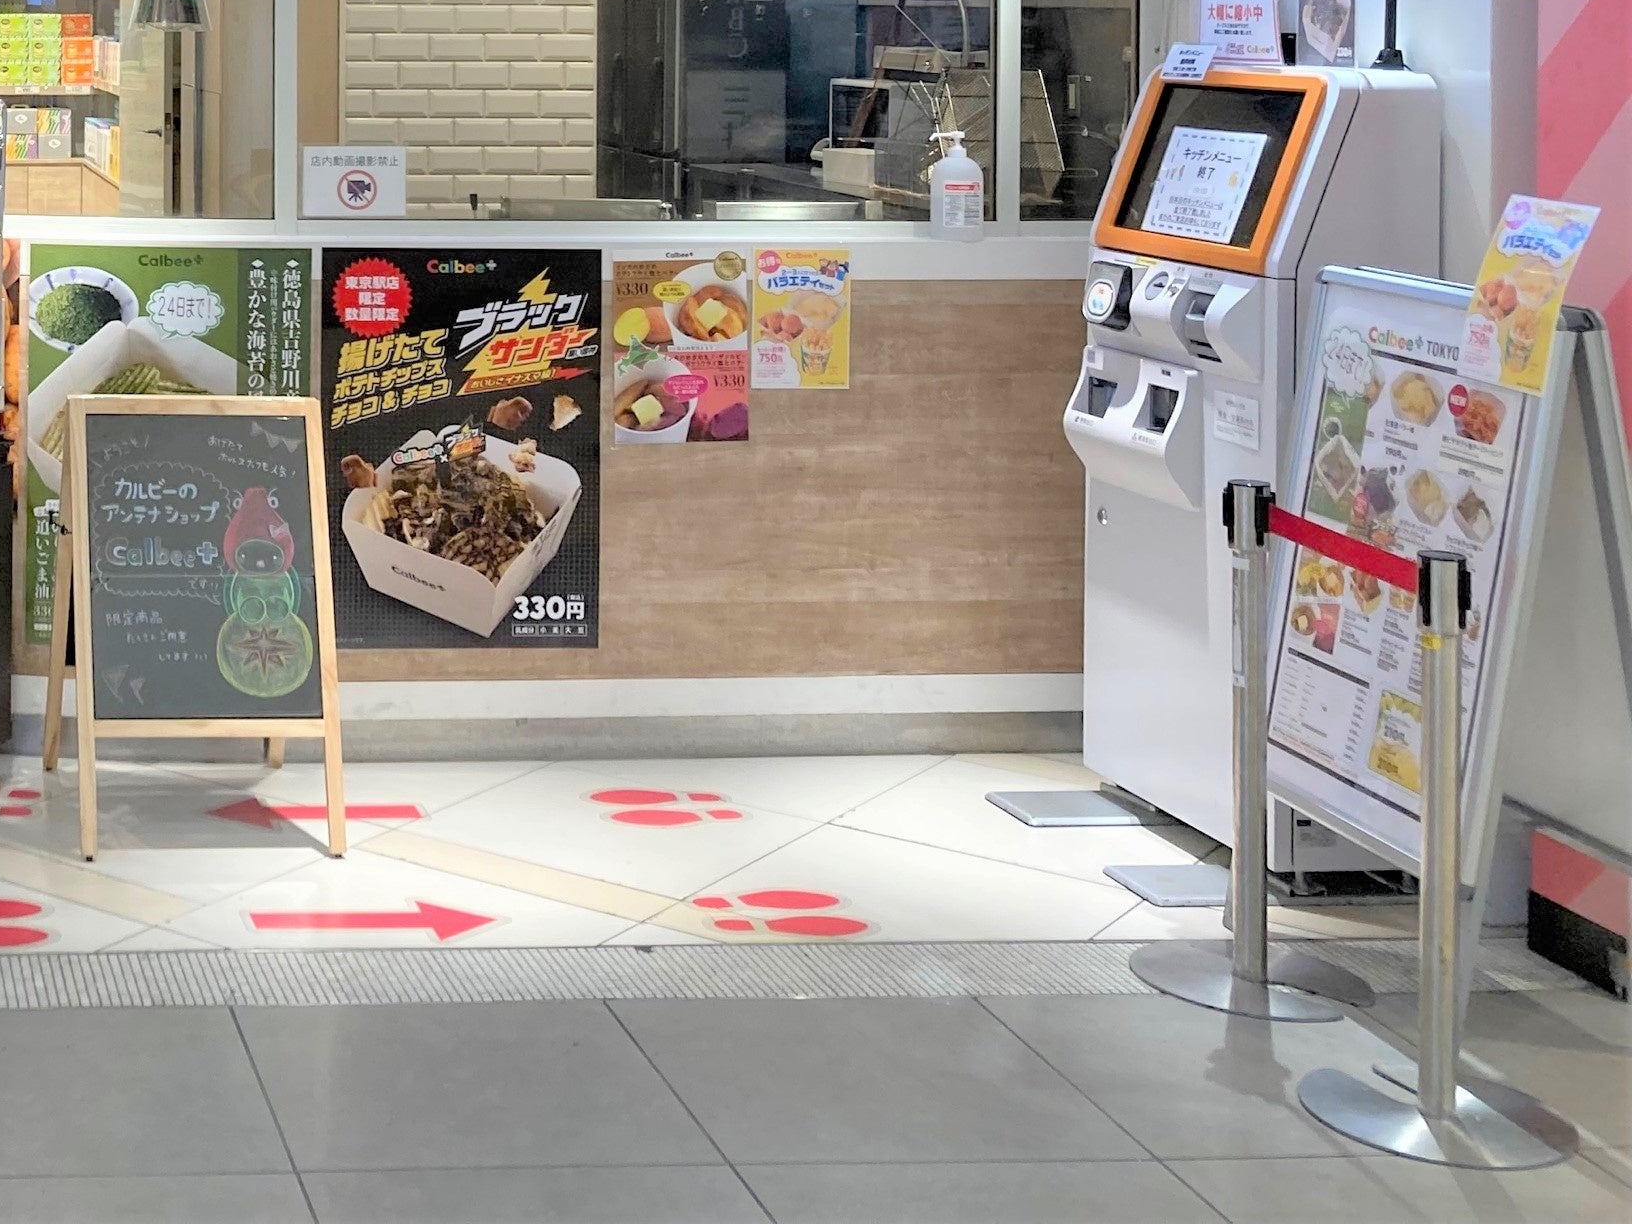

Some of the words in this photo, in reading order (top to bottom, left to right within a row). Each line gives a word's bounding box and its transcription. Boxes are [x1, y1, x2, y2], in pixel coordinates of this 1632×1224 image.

[1207, 3, 1264, 22] 大幅に縮小中
[310, 154, 400, 168] 店内動画撮影禁止
[1183, 147, 1242, 164] キッチンメニュー
[1196, 165, 1216, 181] 終了
[426, 259, 498, 275] Calbee+
[344, 276, 400, 290] 東京駅店
[357, 292, 386, 306] 限定
[344, 307, 400, 322] 数量限定
[452, 292, 589, 359] ブラック
[246, 268, 267, 397] 豊かな海苔の
[282, 269, 302, 398] 徳島県吉野川
[337, 328, 449, 378] 揚げたて
[488, 326, 594, 369] サンダー
[1426, 340, 1461, 362] TOKYO
[333, 357, 446, 403] ポテトチップス
[401, 379, 452, 408] チョコ
[114, 476, 198, 501] カルビーの
[100, 500, 220, 525] アンテナショップ
[105, 609, 164, 628] 限定商品
[512, 594, 585, 621] 330円
